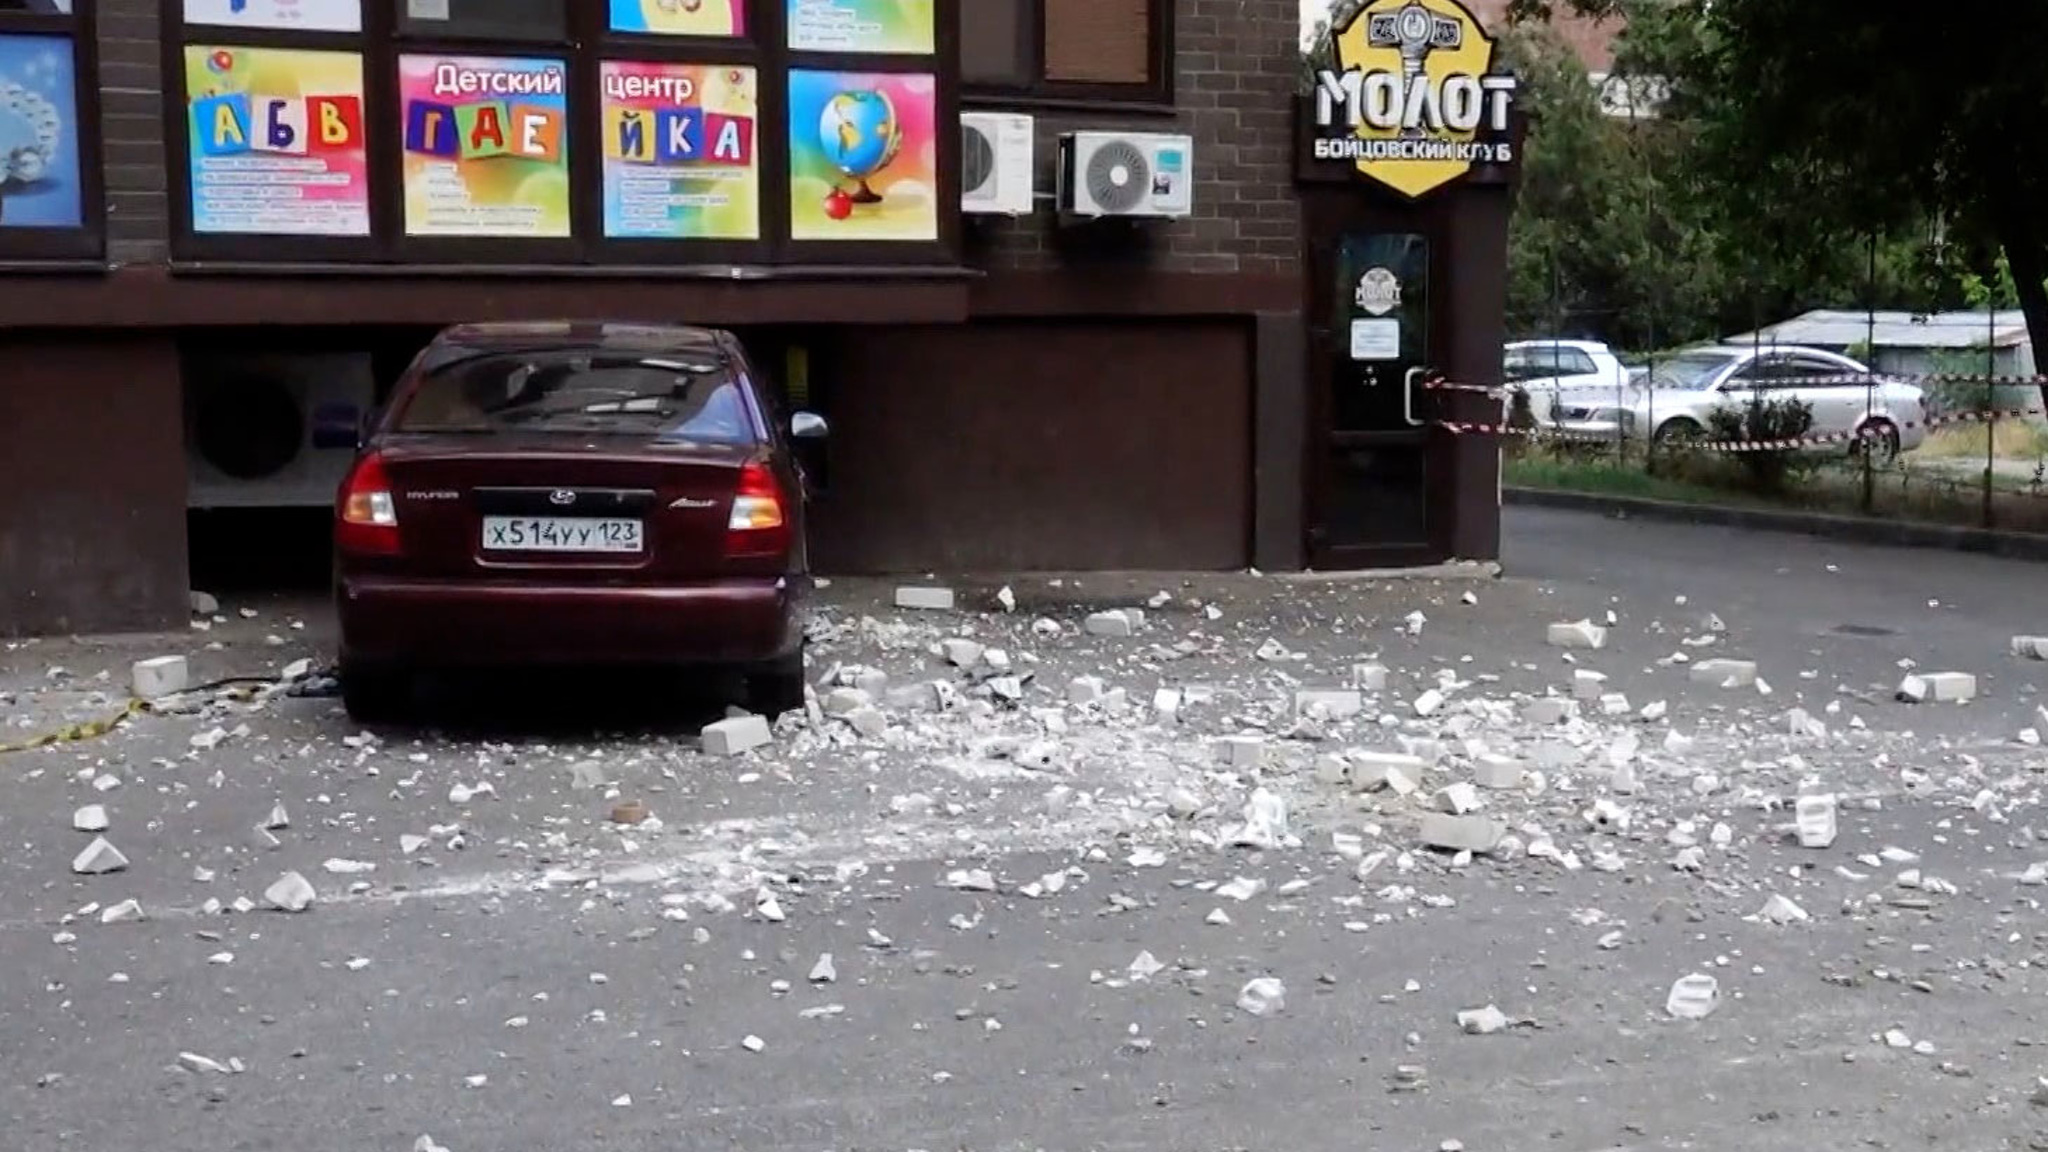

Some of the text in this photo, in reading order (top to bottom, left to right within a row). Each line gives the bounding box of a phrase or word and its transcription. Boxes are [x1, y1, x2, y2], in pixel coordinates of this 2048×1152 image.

[435, 64, 693, 104] Детский центр
[1316, 70, 1516, 131] МОЛОТ
[1315, 135, 1512, 162] БОЙЦОВСКИЙ КЛУБ
